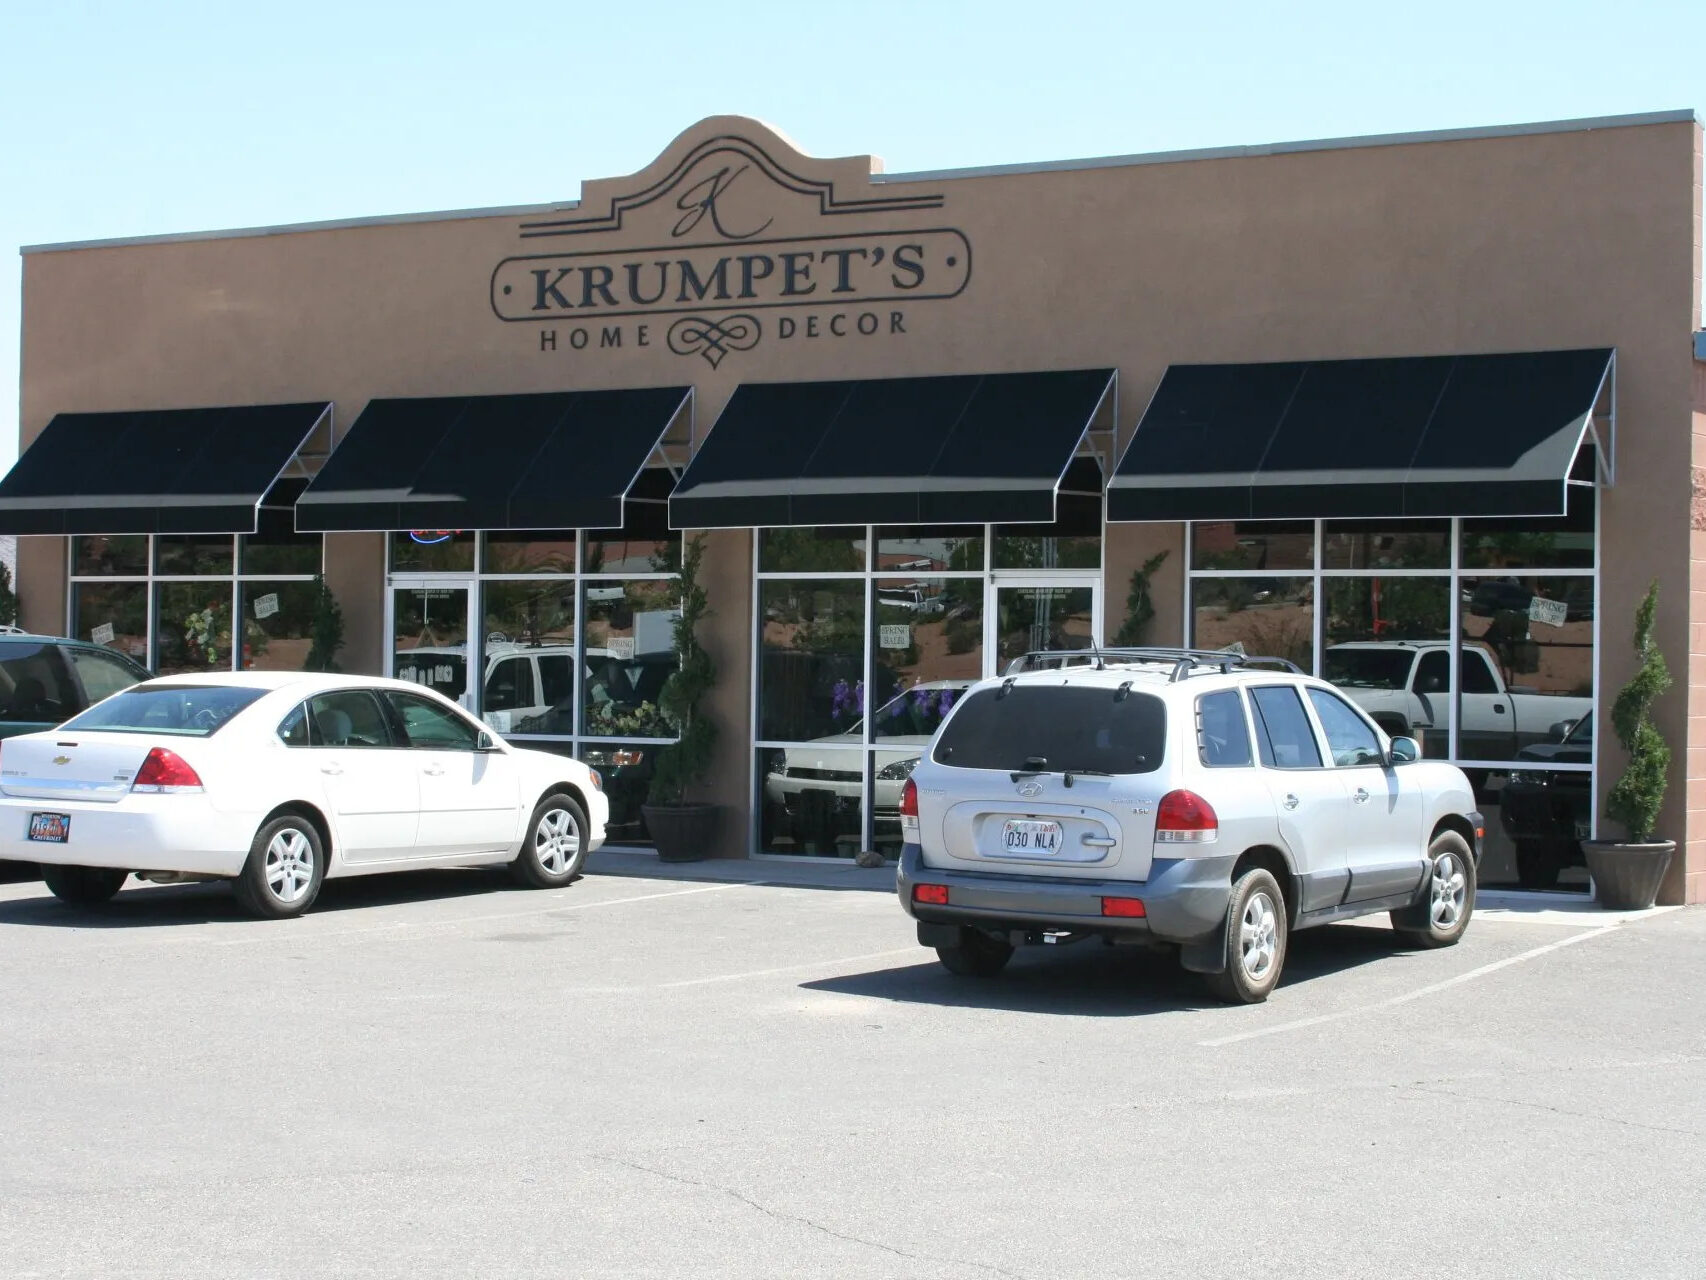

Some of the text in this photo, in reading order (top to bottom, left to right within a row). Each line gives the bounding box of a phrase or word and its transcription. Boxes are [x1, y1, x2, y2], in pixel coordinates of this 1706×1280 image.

[531, 244, 926, 311] KRUMPET'S
[540, 312, 907, 351] HOME DECOR
[1532, 598, 1565, 613] SPRING
[881, 626, 908, 635] SPRING
[1007, 831, 1055, 849] 030 NLA
